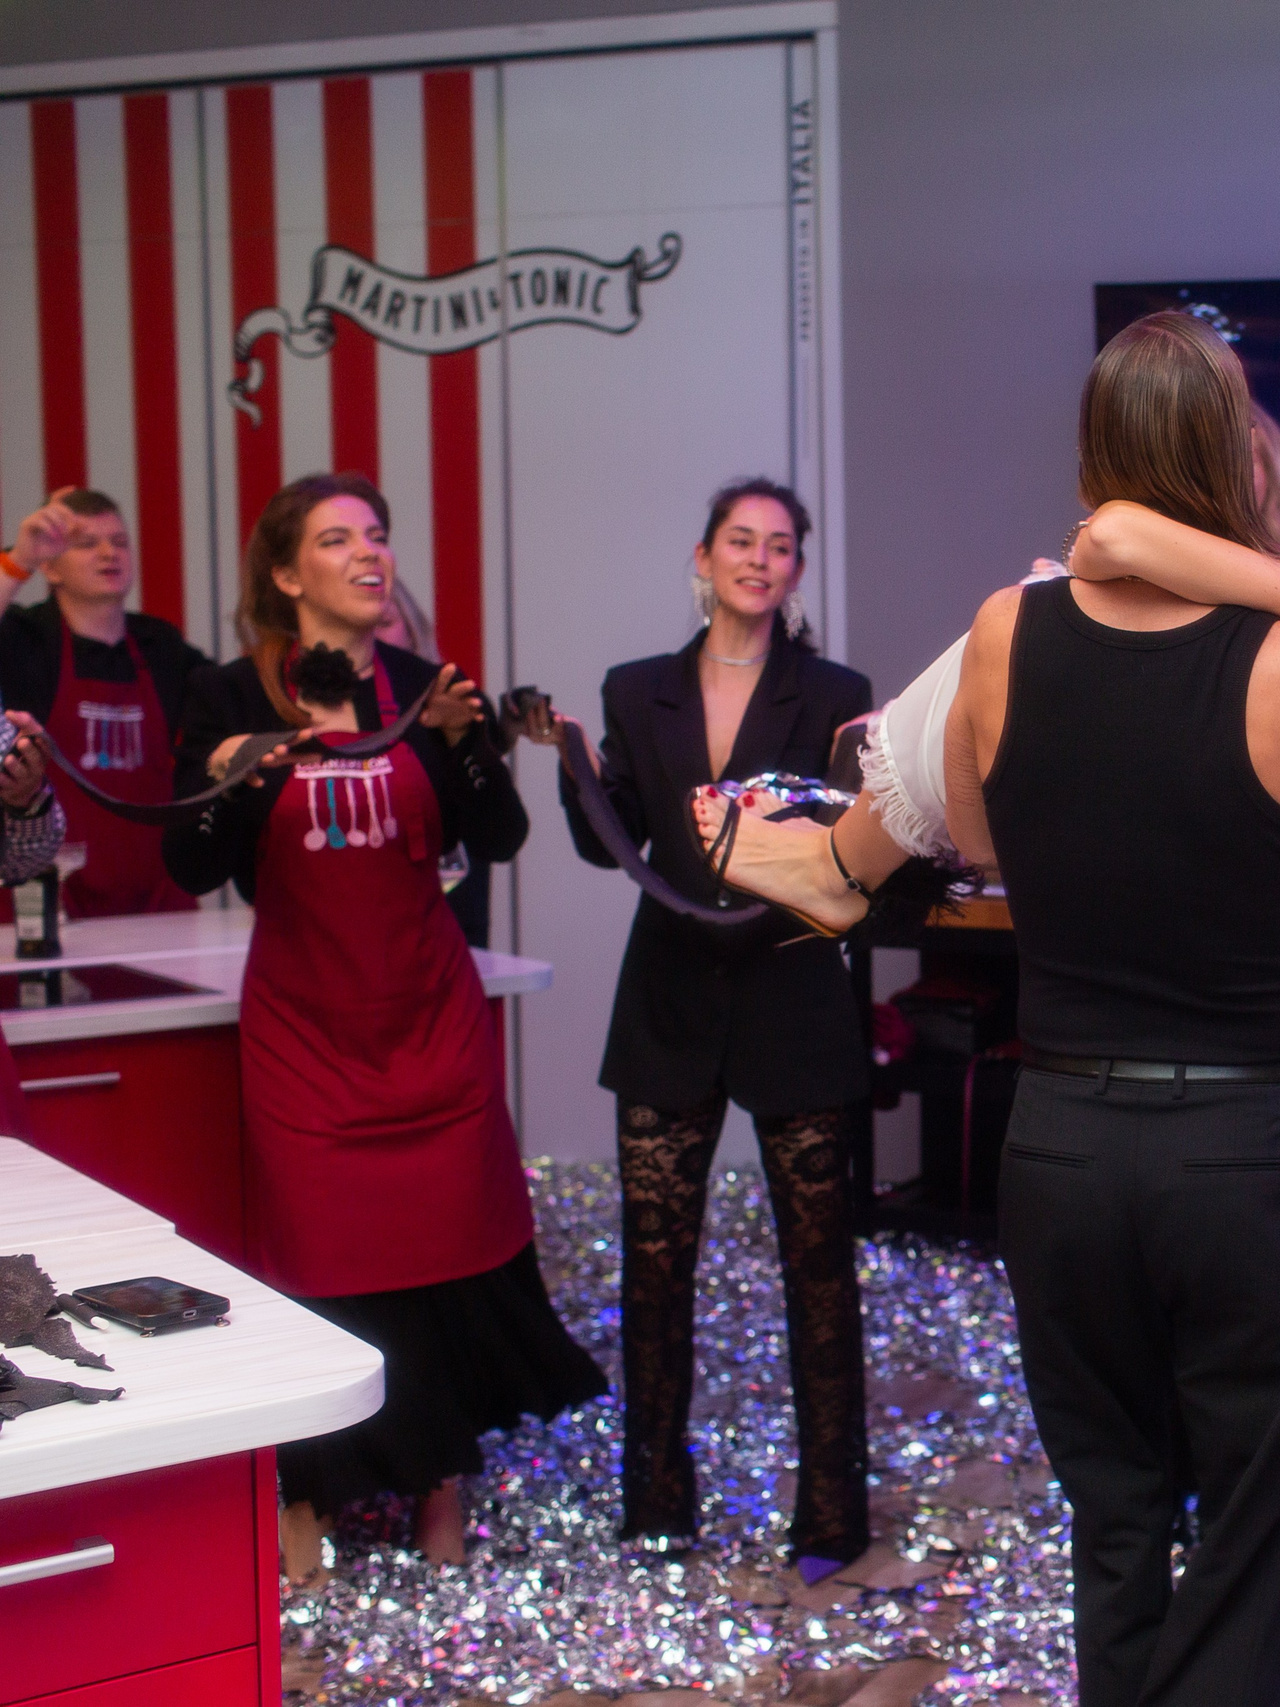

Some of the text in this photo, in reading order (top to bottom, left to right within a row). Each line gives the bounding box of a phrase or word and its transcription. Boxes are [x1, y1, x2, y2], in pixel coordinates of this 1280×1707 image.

[791, 99, 812, 206] ITALIA
[339, 265, 485, 335] MARTINI
[507, 268, 609, 315] TONIC
